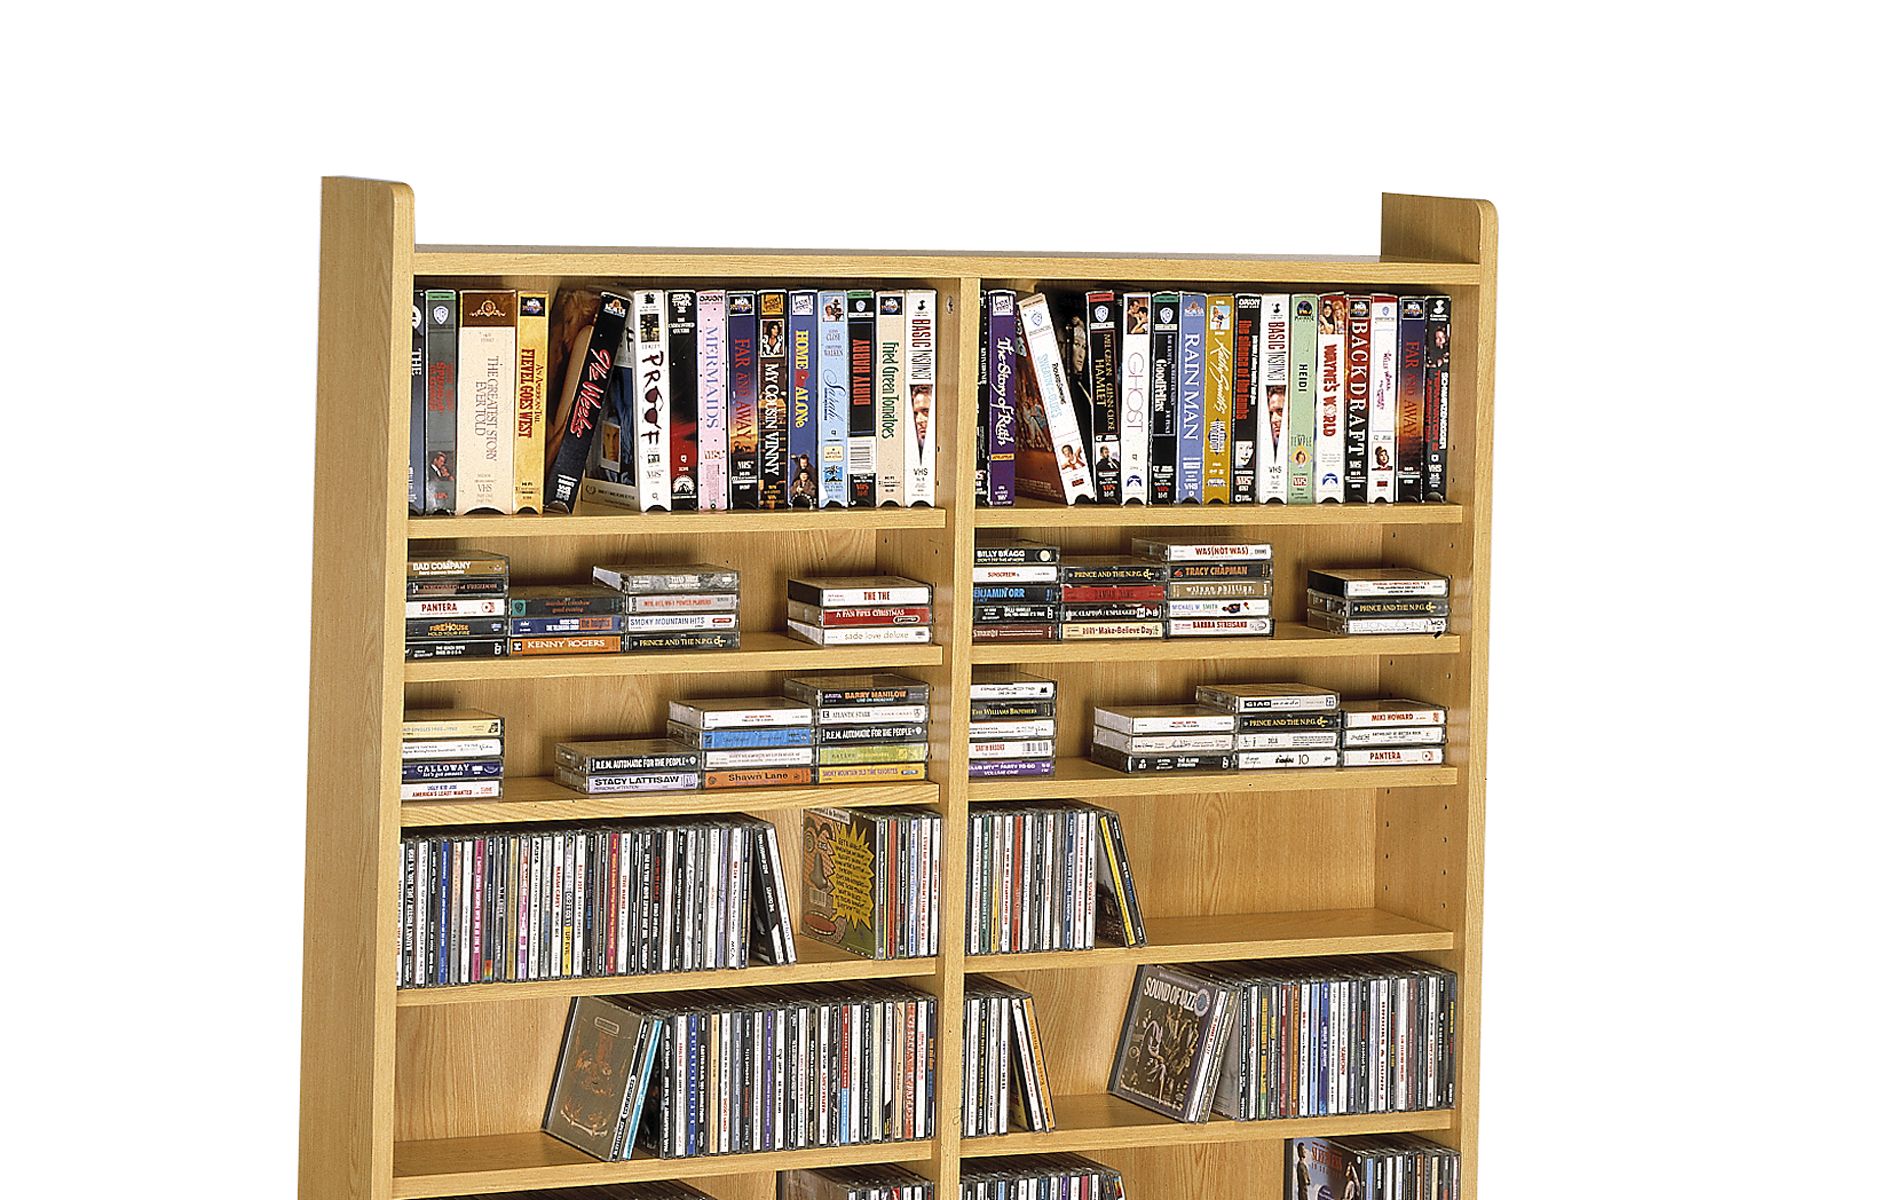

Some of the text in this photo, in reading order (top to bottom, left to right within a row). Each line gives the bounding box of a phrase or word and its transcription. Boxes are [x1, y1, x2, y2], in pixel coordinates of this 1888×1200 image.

[795, 330, 809, 370] HOME
[911, 318, 932, 381] BASIC INSTINCT
[996, 337, 1015, 359] The
[1267, 321, 1287, 381] BASIC INSTINCT
[704, 326, 719, 429] MERMAIDS
[852, 338, 872, 406] DIRTY HARRY
[1298, 364, 1309, 392] HEIDI
[990, 361, 1013, 396] Story
[1094, 358, 1107, 407] HAMLET
[734, 338, 752, 441] FAR AND AWAY
[881, 342, 900, 439] Fried Green Tomatoes
[1126, 352, 1145, 433] GHOST
[1183, 333, 1200, 441] RAIN MAN
[1322, 343, 1341, 437] WAYNE'S WORLD
[1348, 320, 1369, 457] BACKDRAFT
[1403, 341, 1421, 437] FAR AND AWAY
[518, 349, 535, 438] FIEVEL GOES WEST
[474, 381, 487, 436] EVER TOLD
[485, 356, 499, 461] THE GREATEST STORY
[764, 362, 780, 476] MY COUSIN VINNY
[994, 410, 1015, 447] Ruth
[913, 468, 929, 476] VHS
[1268, 466, 1282, 474] VHS
[976, 549, 1026, 558] BILLY BRAGG
[413, 561, 472, 571] BAD COMPANY
[1185, 566, 1248, 576] TRACY CHAPMAN
[863, 591, 890, 600] THE THE
[973, 588, 1025, 598] ENJAMIN ORR
[421, 603, 458, 612] PANTERA
[429, 622, 469, 632] FIREHOUSE
[630, 616, 706, 626] SMOKY MOUNTAIN HITS
[1192, 620, 1248, 629] BARBRA STREISAND
[844, 630, 909, 640] sade love deluxe
[1141, 625, 1153, 635] Day
[527, 638, 606, 649] KENNY ROGERS
[639, 638, 665, 647] PRINCE
[665, 638, 681, 646] AND
[681, 637, 695, 646] THE
[871, 690, 907, 698] MANILOW
[1249, 719, 1272, 727] PRINCE
[1287, 718, 1300, 726] THE
[1387, 713, 1414, 721] HOWARD
[842, 730, 871, 739] AUTOMATIC
[871, 729, 882, 738] FOR
[882, 728, 892, 737] THE
[892, 727, 913, 737] PEOPLE
[1298, 754, 1310, 765] 10
[1369, 751, 1402, 761] PANTERA
[417, 764, 470, 773] CALLOWAY
[613, 760, 643, 769] AUTOMATIC
[643, 759, 655, 768] FOR
[655, 758, 665, 767] THE
[665, 757, 687, 767] PEOPLE
[594, 775, 680, 786] STACY LATTISAW
[728, 772, 789, 782] Shawn Lane
[1144, 976, 1172, 1002] SOUND
